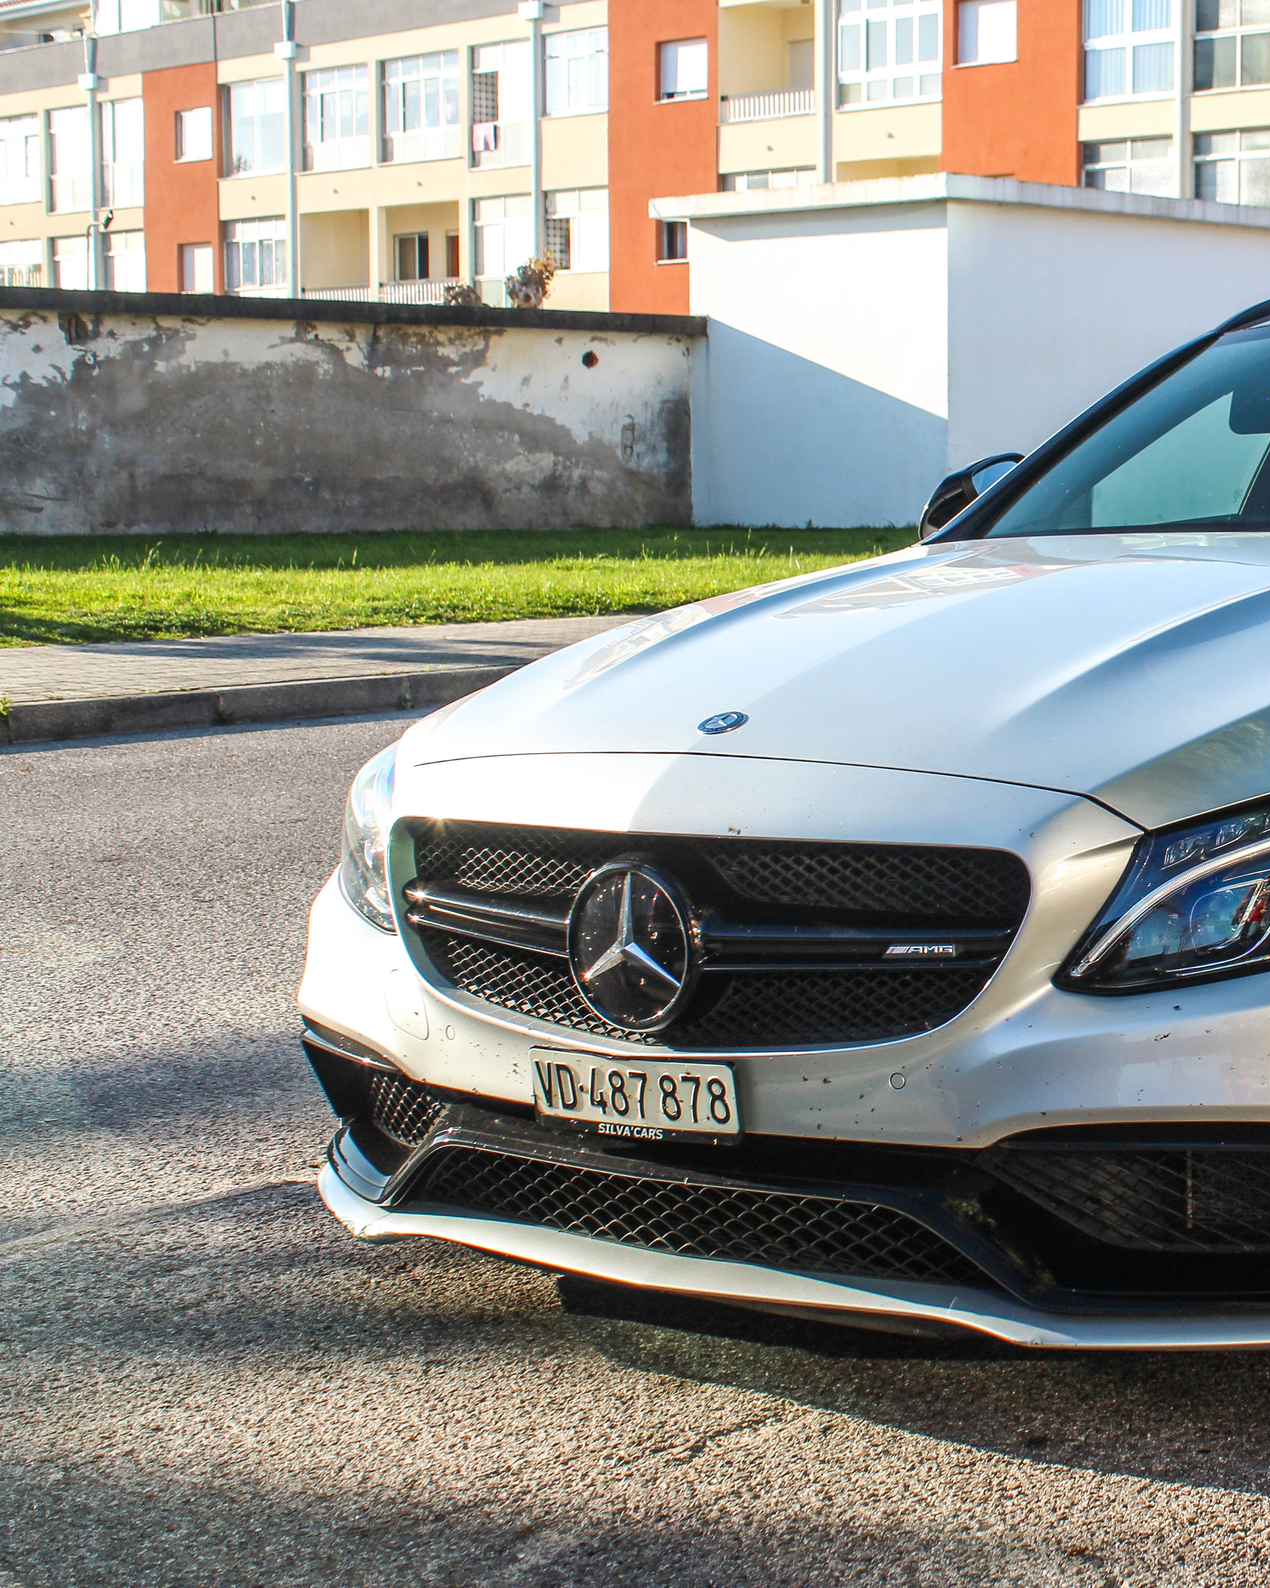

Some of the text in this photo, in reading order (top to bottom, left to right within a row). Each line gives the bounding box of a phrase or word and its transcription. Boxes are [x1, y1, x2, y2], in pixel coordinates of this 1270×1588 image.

[907, 945, 953, 954] AMG
[658, 1074, 731, 1125] 878
[598, 1122, 664, 1140] SILVA'CARS
